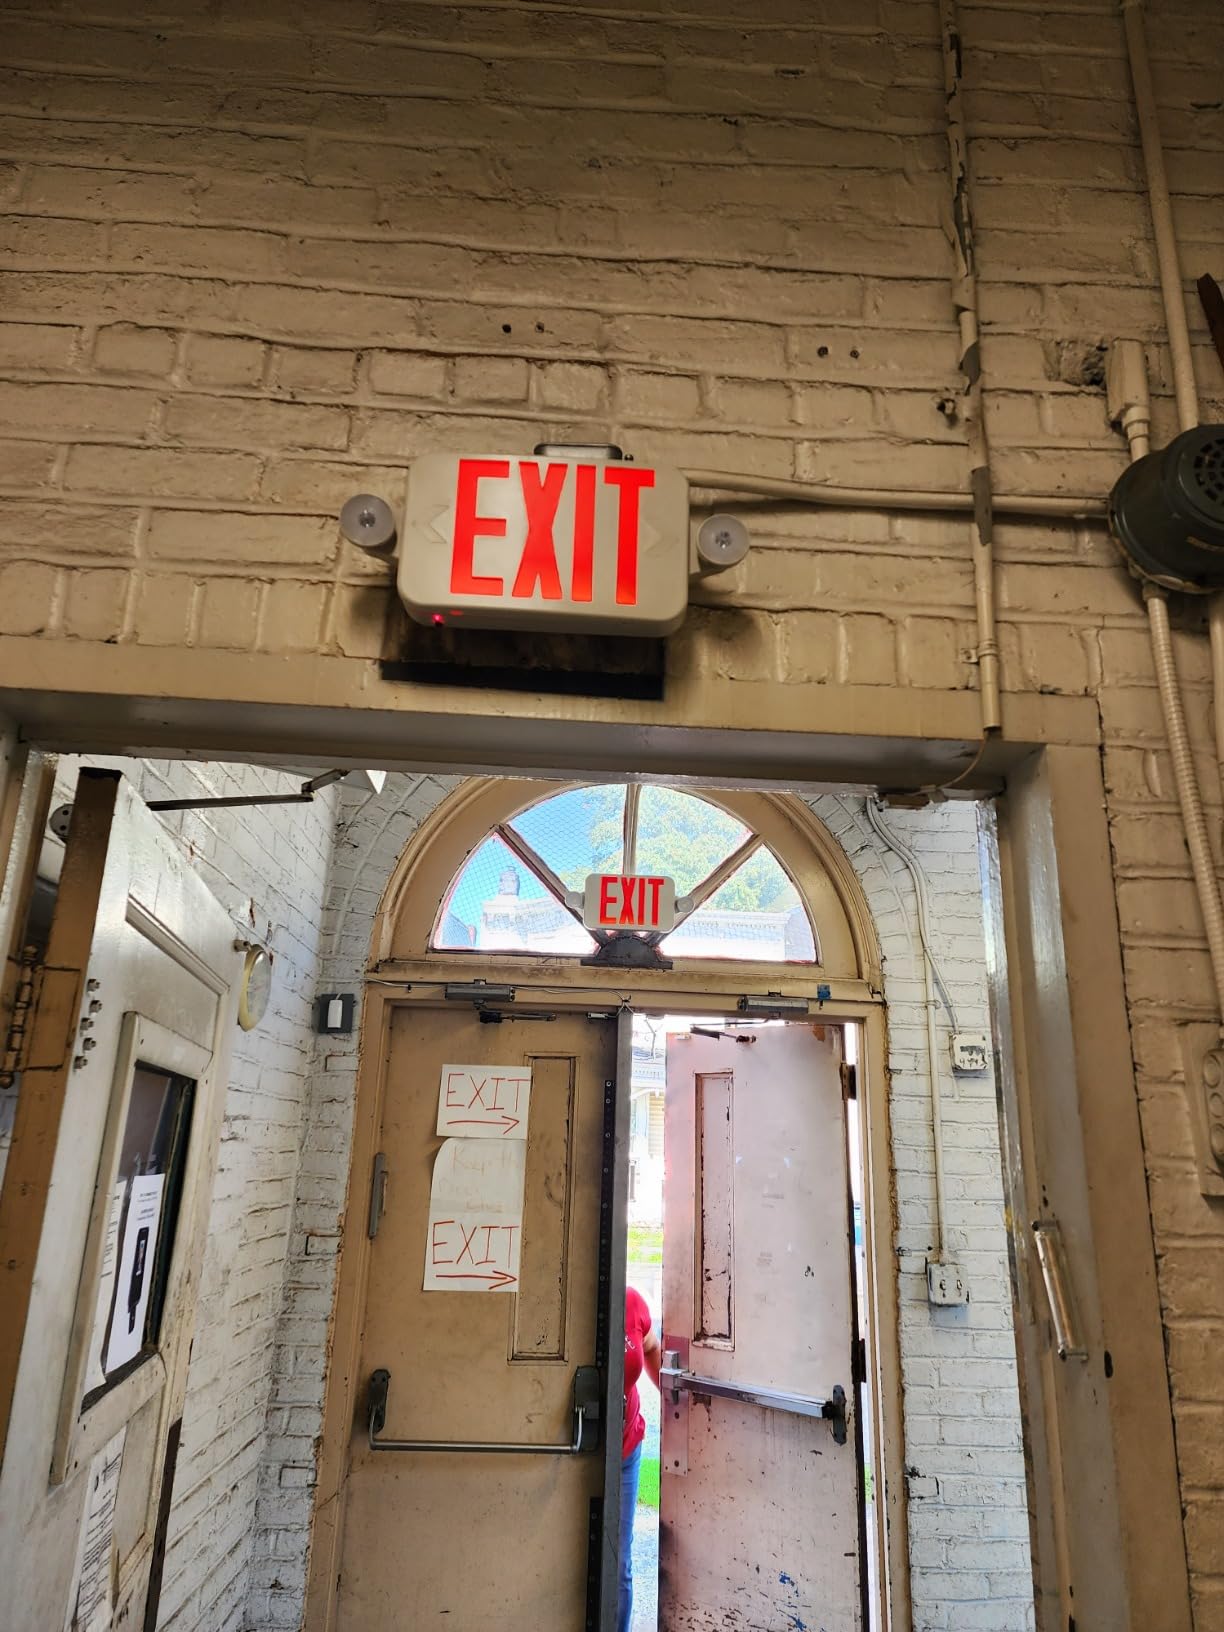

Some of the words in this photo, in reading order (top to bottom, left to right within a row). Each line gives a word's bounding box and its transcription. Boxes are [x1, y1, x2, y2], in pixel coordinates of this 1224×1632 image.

[450, 459, 655, 605] EXIT
[599, 876, 665, 926] EXIT
[446, 1073, 530, 1113] EXIT
[432, 1220, 520, 1269] EXIT
